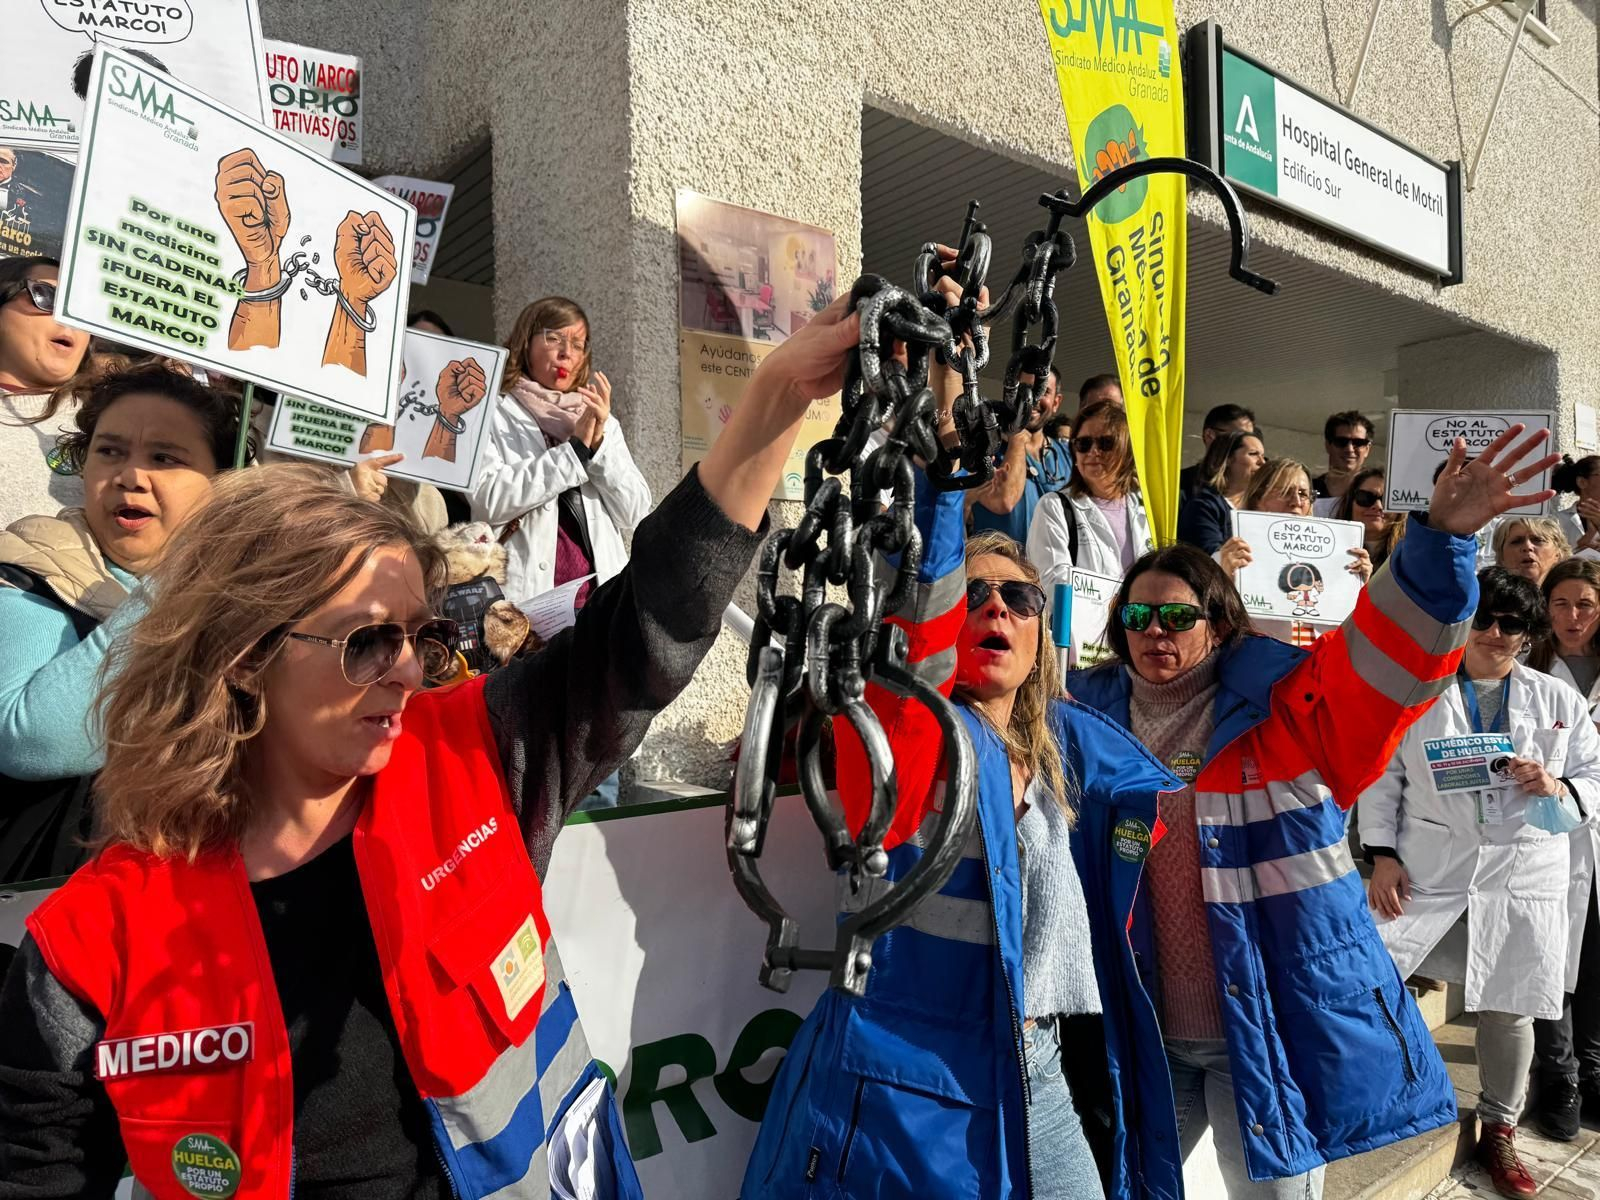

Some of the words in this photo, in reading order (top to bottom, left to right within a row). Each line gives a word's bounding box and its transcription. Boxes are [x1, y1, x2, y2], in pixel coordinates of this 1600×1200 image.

[78, 11, 167, 34] MARCO!
[303, 59, 357, 94] MARCO
[1093, 56, 1126, 73] Médico
[1127, 61, 1156, 80] Andaluz
[108, 65, 195, 125] SMA
[1129, 77, 1168, 103] Granada
[0, 98, 71, 127] SMA
[108, 97, 138, 116] Sindicato
[140, 112, 163, 129] Médico
[163, 131, 199, 152] Granada
[1224, 133, 1237, 146] unta
[1282, 113, 1341, 166] Hospital
[1344, 147, 1393, 192] General
[1395, 173, 1409, 200] de
[1411, 181, 1444, 217] Motril
[1283, 157, 1322, 191] Edificio
[1324, 176, 1341, 200] Sur
[0, 219, 31, 246] arco
[132, 199, 171, 225] Por
[176, 221, 216, 245] una
[87, 229, 126, 253] SIN
[121, 221, 220, 267] medicina
[102, 258, 187, 298] ¡FUERA
[193, 290, 219, 309] EL
[103, 281, 217, 329] ESTATUTO
[111, 306, 204, 347] MARCO!
[700, 343, 761, 365] Ayúdanos
[701, 363, 722, 375] este
[1138, 357, 1160, 398] de
[285, 399, 306, 411] SIN
[292, 412, 337, 429] ¡FUERA
[341, 423, 356, 433] EL
[1446, 420, 1467, 428] NO
[1471, 420, 1488, 428] AL
[291, 425, 353, 444] ESTATUTO
[294, 437, 346, 454] MARCO!
[1391, 489, 1428, 503] SMA
[1273, 531, 1331, 545] ESTATUTO
[1284, 523, 1301, 533] NO
[1304, 525, 1318, 534] AL
[1283, 542, 1323, 553] MARCO!
[1073, 575, 1100, 597] SMA
[1243, 593, 1271, 607] SMA
[1425, 742, 1440, 750] TU
[1441, 750, 1456, 758] DE
[1457, 745, 1501, 757] HUELGA
[1171, 758, 1201, 766] HUELGA
[1115, 826, 1149, 843] HUELGA
[1120, 837, 1131, 845] POR
[420, 816, 499, 892] URGENCIAS
[1116, 841, 1144, 853] ESTATUTO
[1119, 847, 1139, 857] PROPIO
[97, 1025, 250, 1078] MEDICO
[174, 1151, 235, 1170] HUELGA
[181, 1172, 229, 1187] ESTATUTO
[186, 1166, 206, 1177] POR
[207, 1170, 222, 1179] UN
[189, 1180, 224, 1193] PROPIO
